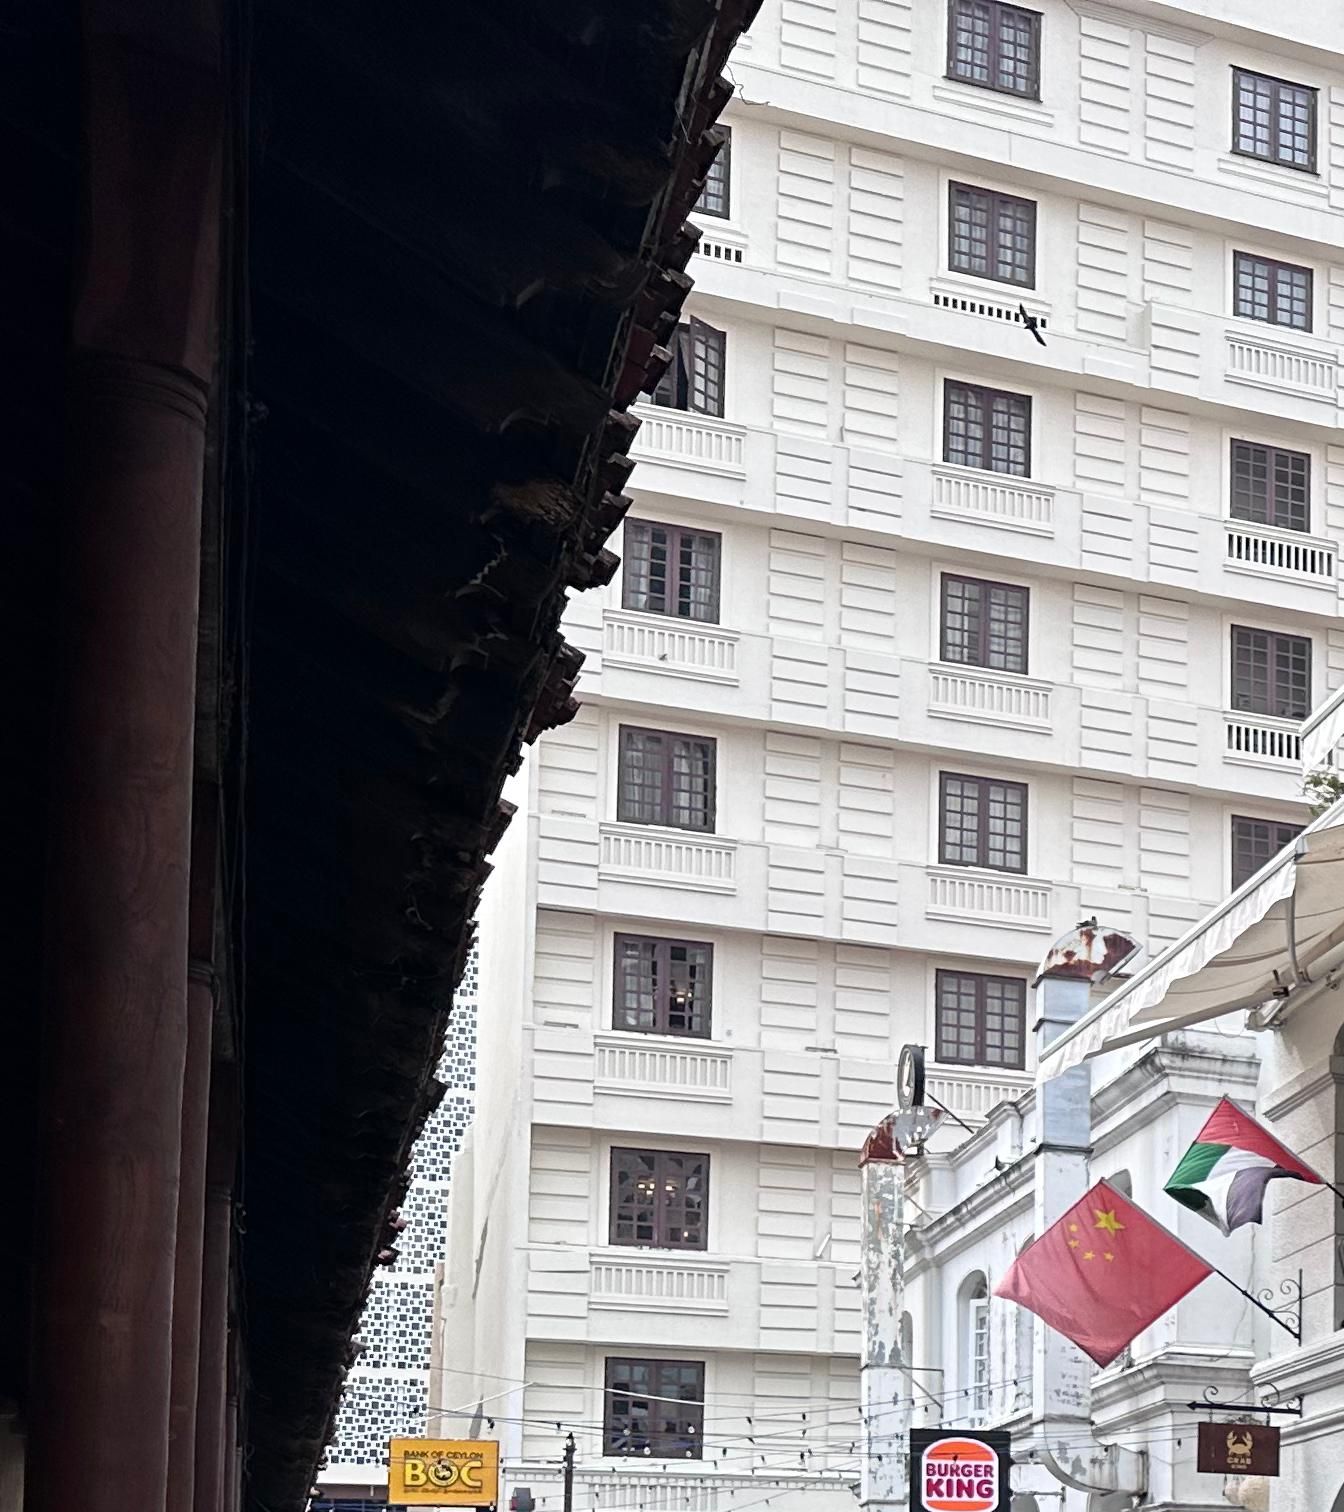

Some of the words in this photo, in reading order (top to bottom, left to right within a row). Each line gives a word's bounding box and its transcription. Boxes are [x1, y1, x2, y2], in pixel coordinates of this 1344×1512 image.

[404, 1450, 429, 1458] BANK
[430, 1450, 444, 1458] OF
[445, 1451, 483, 1459] CEYLON
[404, 1458, 483, 1488] BOC
[925, 1462, 995, 1478] BURGER
[925, 1478, 995, 1499] KING
